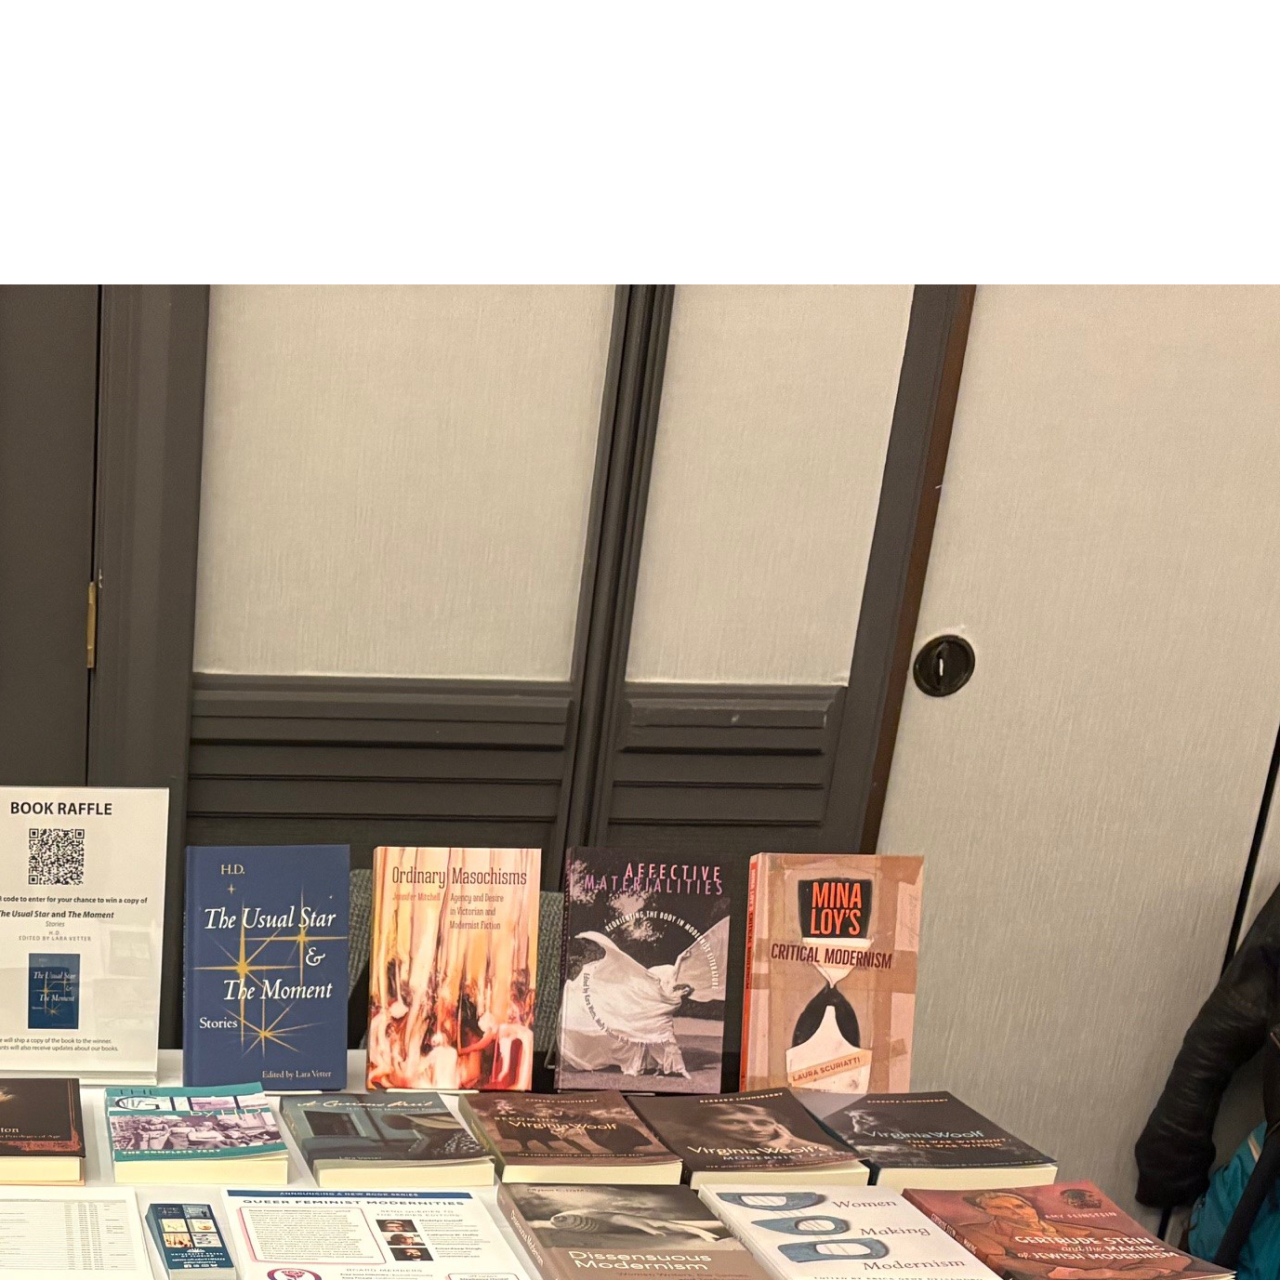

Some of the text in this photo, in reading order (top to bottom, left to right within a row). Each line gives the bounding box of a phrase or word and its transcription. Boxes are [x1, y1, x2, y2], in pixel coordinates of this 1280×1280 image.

[10, 802, 113, 816] BOOK RAFFLE
[220, 864, 246, 875] H.D.
[624, 862, 721, 882] AFFECTIVE
[392, 866, 527, 889] Ordinary Masochisms
[584, 874, 723, 895] MATERIALITIES
[73, 896, 97, 904] chance
[811, 882, 862, 909] MINA
[11, 910, 33, 918] Usual
[34, 910, 50, 918] Star
[204, 905, 337, 929] The Usual Star
[810, 908, 861, 935] LOY'S
[305, 947, 326, 967] &
[771, 943, 892, 969] CRITICAL MODERNISM
[223, 979, 333, 1001] The Moment
[199, 1017, 238, 1029] Stories
[262, 1070, 332, 1080] Edited by Lara Vetter
[792, 1056, 861, 1082] LAURA SCURIATTI
[508, 1121, 617, 1131] Virginia Woolf
[865, 1129, 985, 1140] Virginia Woolf
[686, 1145, 828, 1157] Virginia Woolf's
[832, 1200, 898, 1209] Women
[860, 1226, 932, 1237] Making
[1014, 1236, 1154, 1245] GERTRUDE STEIN
[1060, 1244, 1166, 1253] and the MAKING
[568, 1250, 712, 1262] Dissensuous
[1031, 1251, 1085, 1260] JEWISH
[1088, 1250, 1180, 1261] MODERNISM
[574, 1259, 708, 1271] Modernism
[863, 1258, 966, 1271] Modernism
